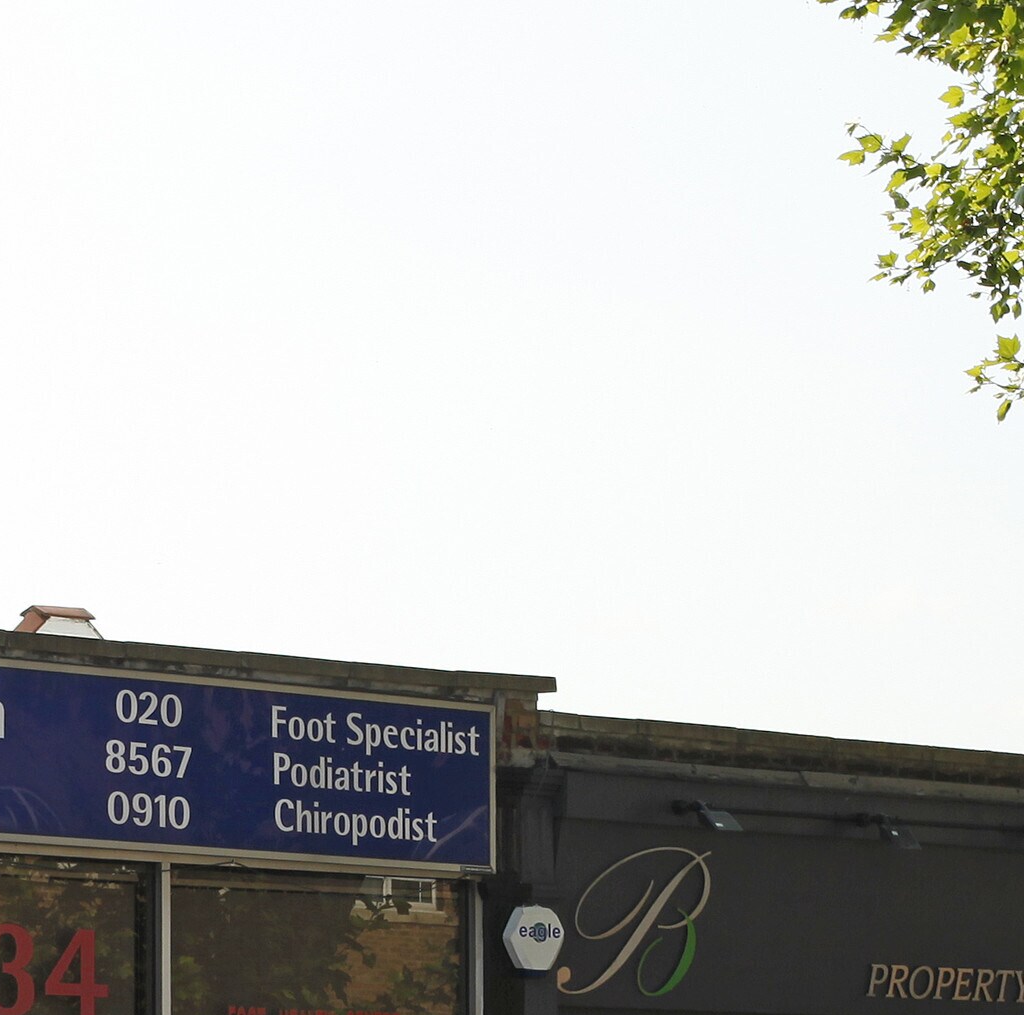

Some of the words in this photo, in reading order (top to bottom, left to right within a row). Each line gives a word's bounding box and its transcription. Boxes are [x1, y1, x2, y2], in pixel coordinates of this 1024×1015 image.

[116, 689, 183, 728] 020
[271, 705, 336, 744] Foot
[346, 712, 480, 757] Specialist
[106, 740, 193, 779] 8567
[272, 753, 412, 797] Podiatrist
[107, 790, 191, 830] 0910
[274, 799, 438, 846] Chiropodist
[519, 923, 561, 943] eagle
[866, 963, 1024, 1003] PROPERTY
